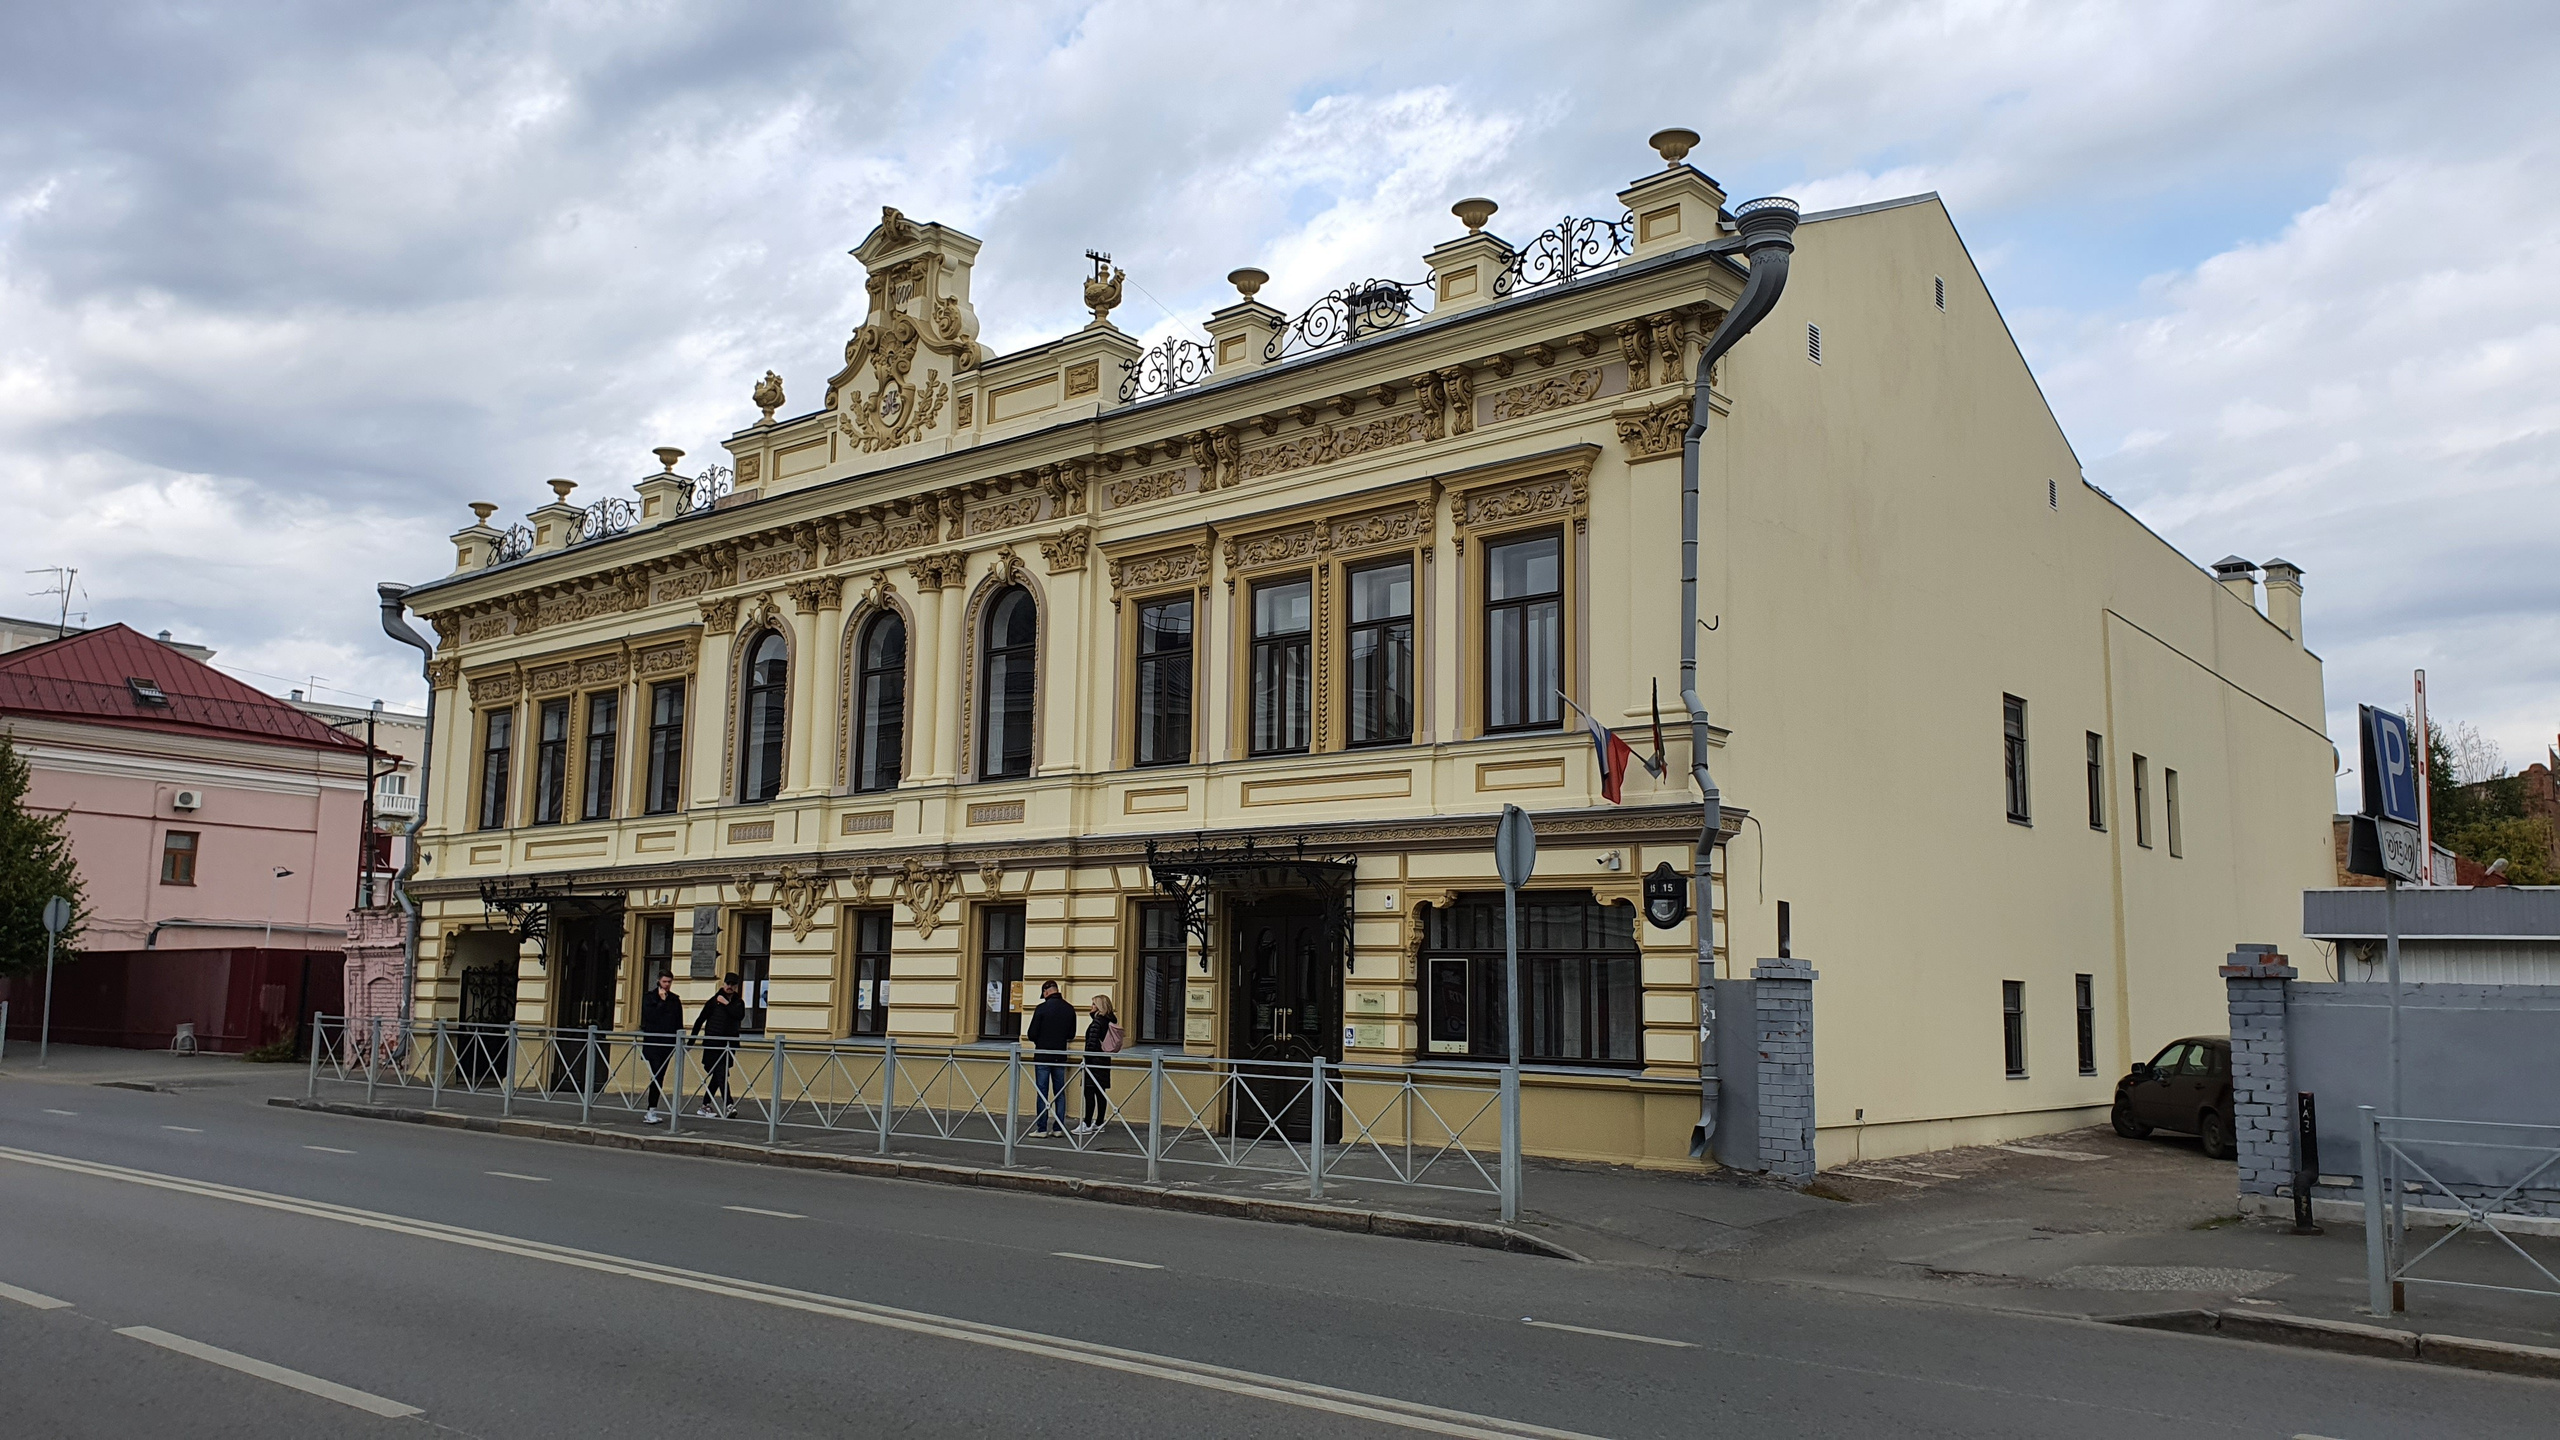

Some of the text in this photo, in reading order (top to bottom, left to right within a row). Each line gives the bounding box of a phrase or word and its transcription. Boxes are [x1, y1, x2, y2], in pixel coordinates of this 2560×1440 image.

[2380, 717, 2405, 812] P
[1649, 883, 1656, 893] 15
[1662, 883, 1674, 893] 15
